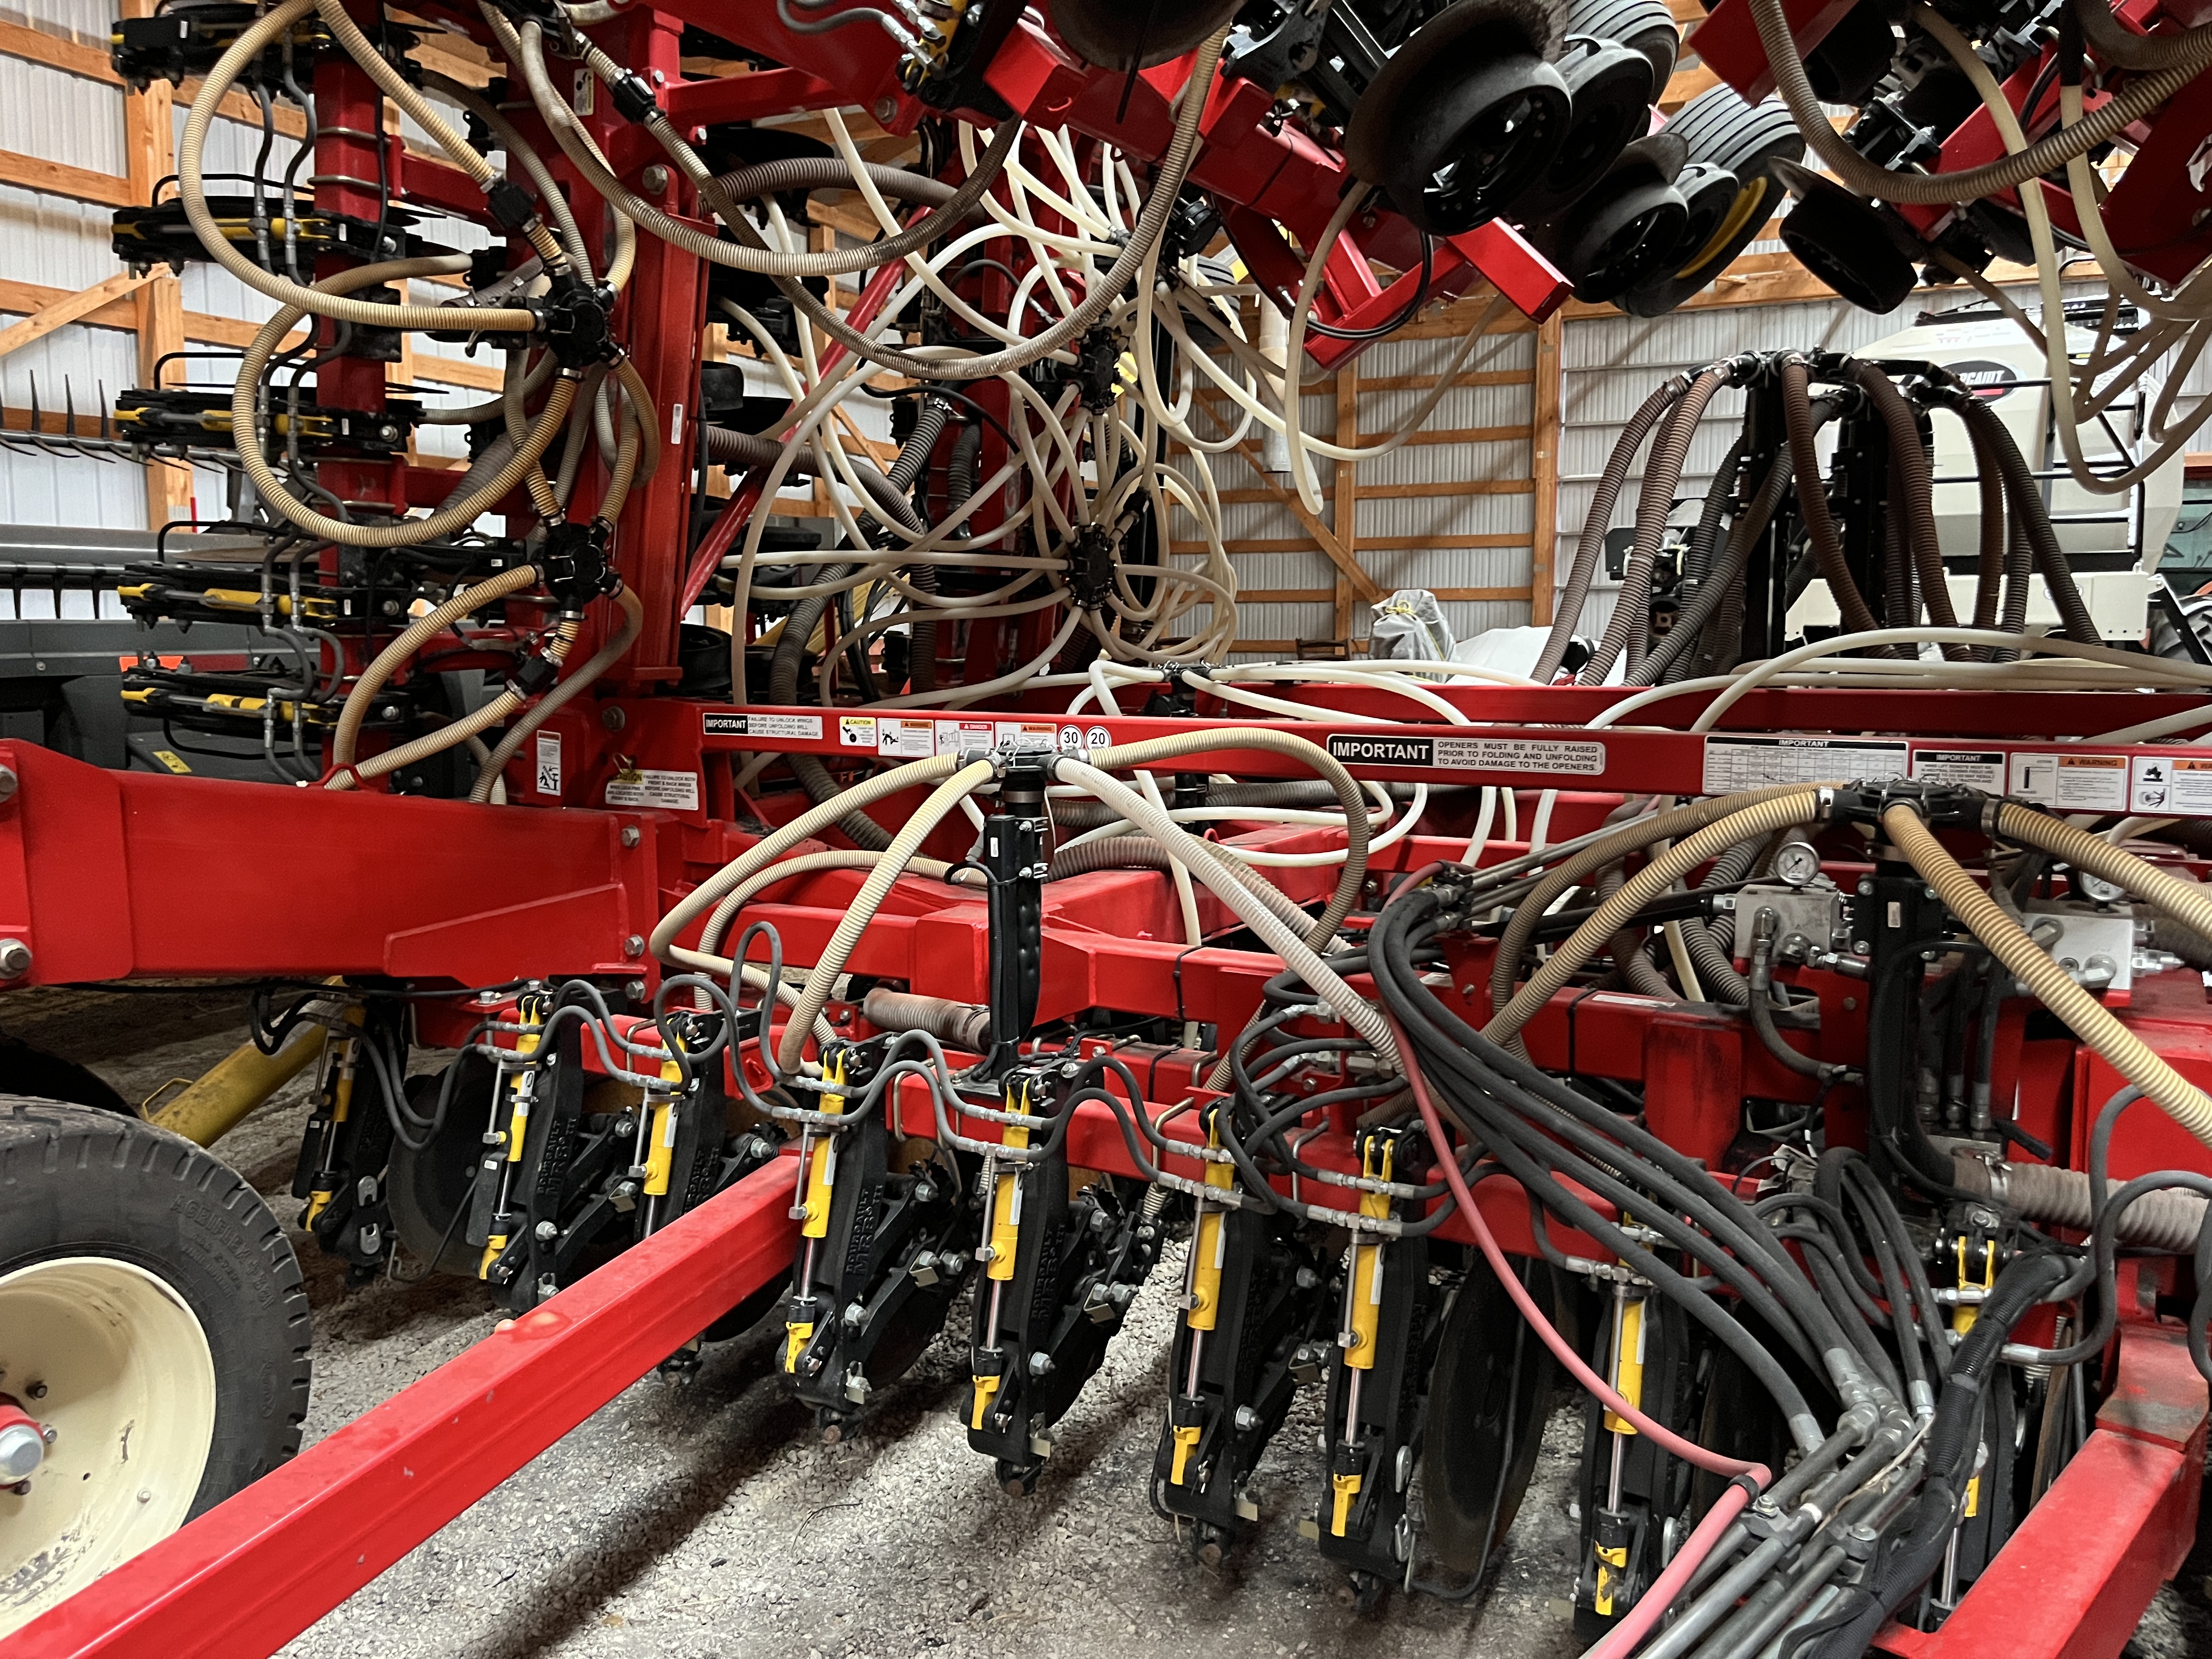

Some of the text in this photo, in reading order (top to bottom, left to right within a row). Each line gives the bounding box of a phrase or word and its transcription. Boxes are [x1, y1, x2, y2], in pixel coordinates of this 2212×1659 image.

[706, 719, 747, 729] IMPORTANT
[1064, 731, 1078, 744] 30
[1091, 732, 1105, 744] 20
[1565, 745, 1598, 753] RAISED
[1779, 740, 1830, 748] IMPORTANT
[1333, 742, 1429, 760] IMPORTANT
[1482, 751, 1520, 759] FOLDING
[1545, 753, 1597, 762] UNFOLDING
[2079, 758, 2117, 766] WARNING
[536, 1120, 561, 1194] BOURGAULT
[684, 1150, 704, 1215] URGAULT
[845, 1188, 870, 1274] BOURGAULT
